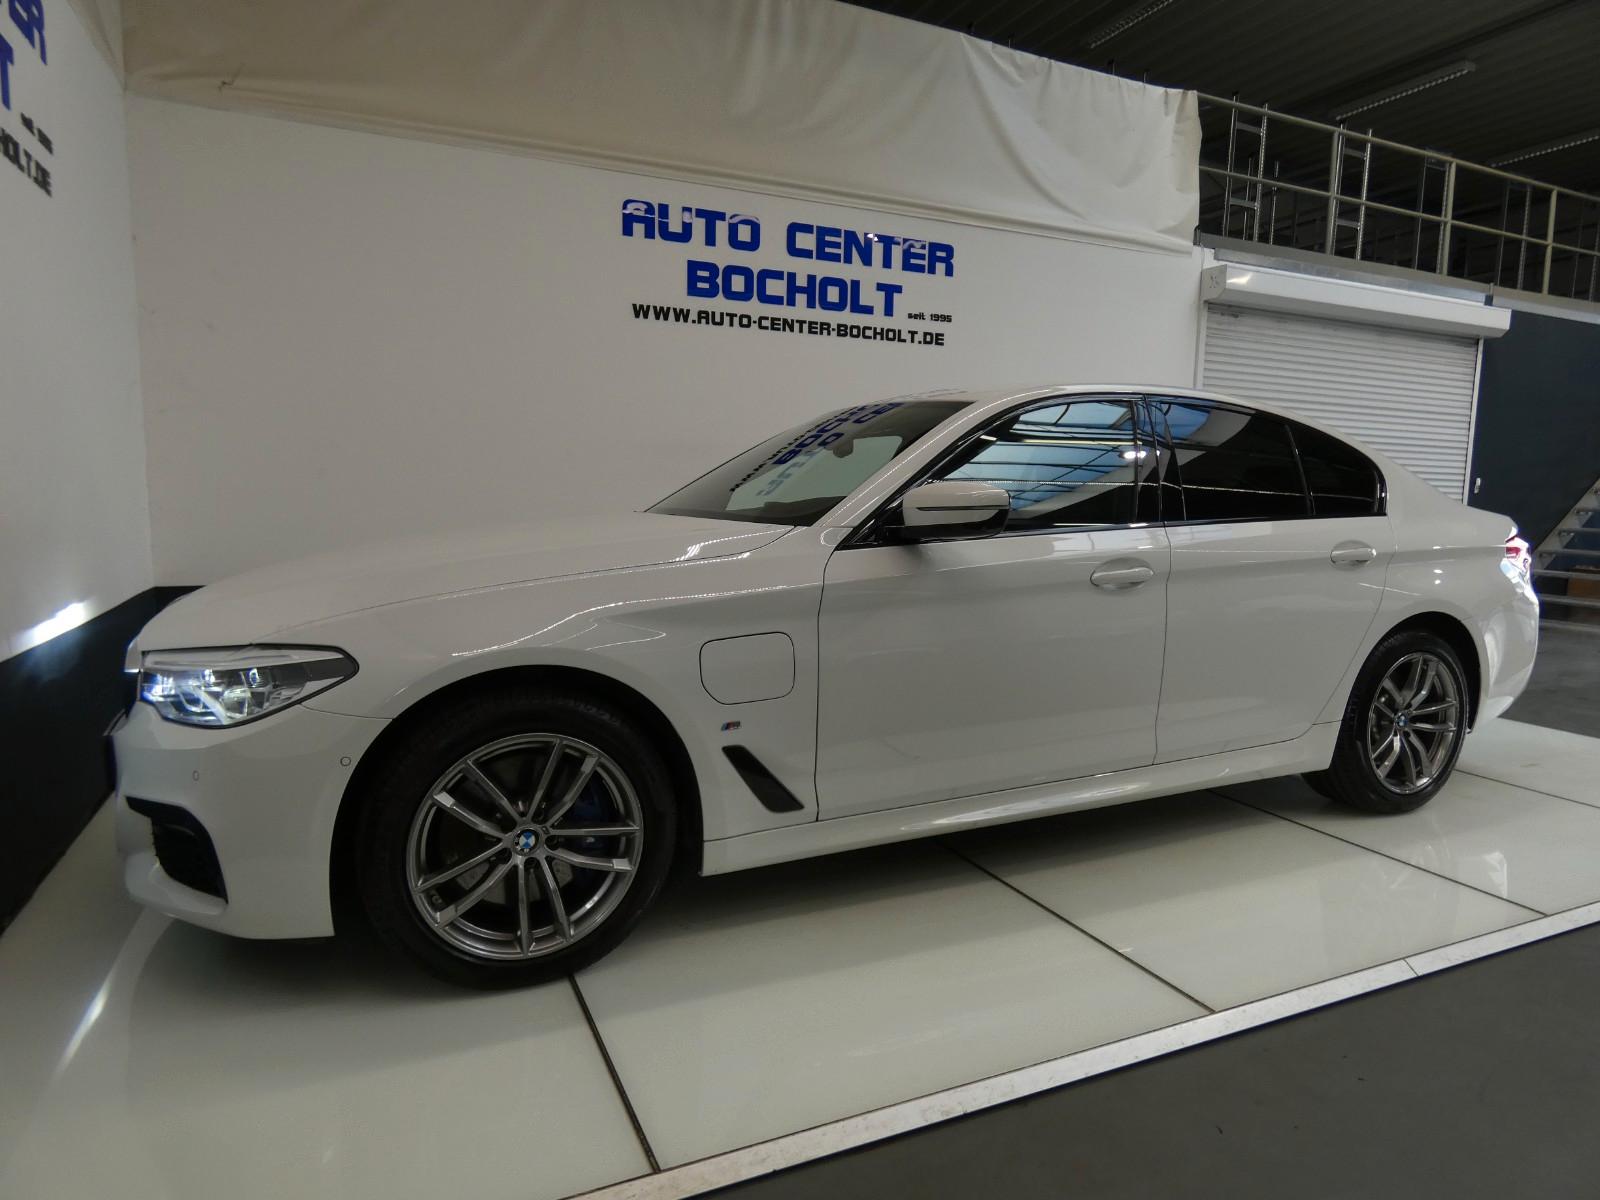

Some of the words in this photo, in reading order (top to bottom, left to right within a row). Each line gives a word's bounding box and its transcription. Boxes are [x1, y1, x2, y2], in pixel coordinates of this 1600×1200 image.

[622, 199, 761, 252] AUTO
[787, 222, 955, 278] CENTER
[687, 259, 903, 317] BOCHOLT
[632, 303, 945, 346] WWW.AUTO-CENTER-BOCHOLT.DE
[929, 313, 953, 323] 1995
